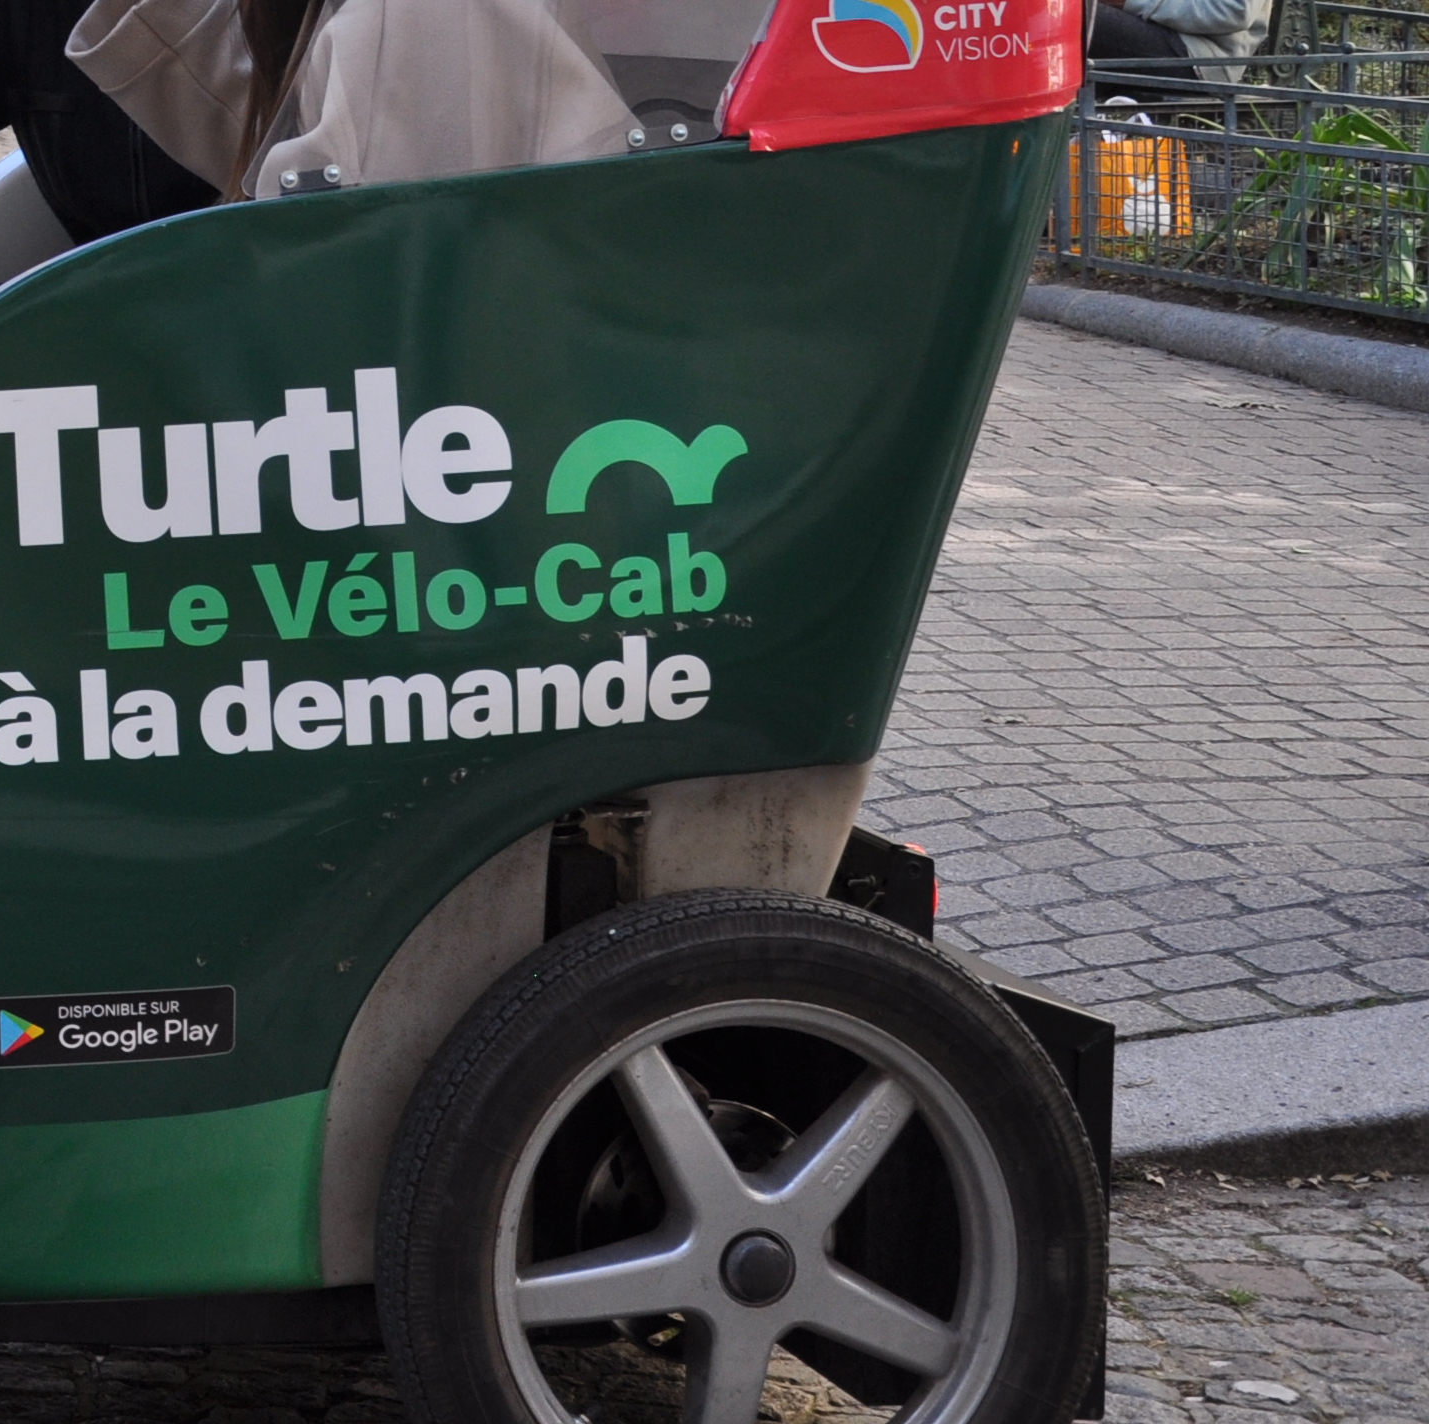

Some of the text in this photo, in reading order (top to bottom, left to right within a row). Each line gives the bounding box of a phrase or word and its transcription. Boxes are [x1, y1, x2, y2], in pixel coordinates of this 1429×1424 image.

[934, 1, 1008, 31] CITY
[935, 32, 1031, 63] VISION
[104, 531, 728, 651] Le Vélo-Cab
[79, 666, 178, 761] la
[198, 634, 710, 756] demande
[58, 1000, 180, 1019] DISPONIBLE SUR
[58, 1018, 219, 1053] Google Play
